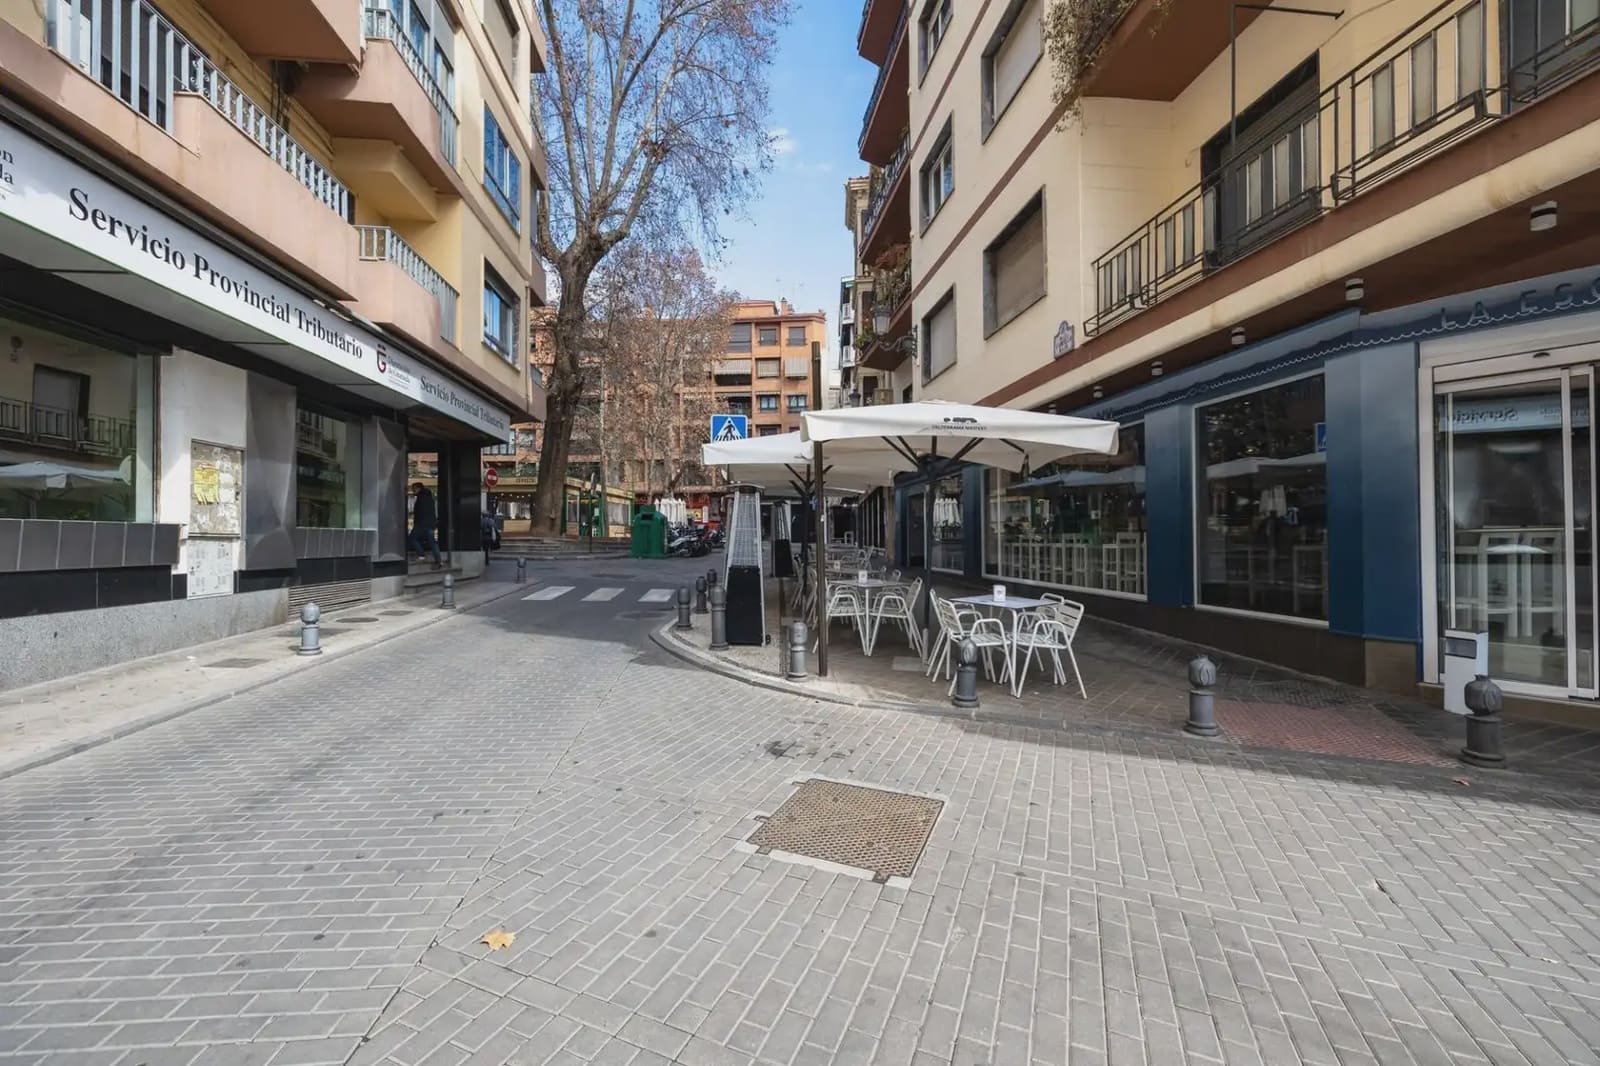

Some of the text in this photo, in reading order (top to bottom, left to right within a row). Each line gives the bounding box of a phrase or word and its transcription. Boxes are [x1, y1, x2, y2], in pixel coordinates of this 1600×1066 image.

[69, 187, 363, 359] Servicio Provincial Tributario
[1441, 301, 1490, 330] LA
[420, 375, 450, 404] Servicio
[450, 391, 480, 418] Provincial
